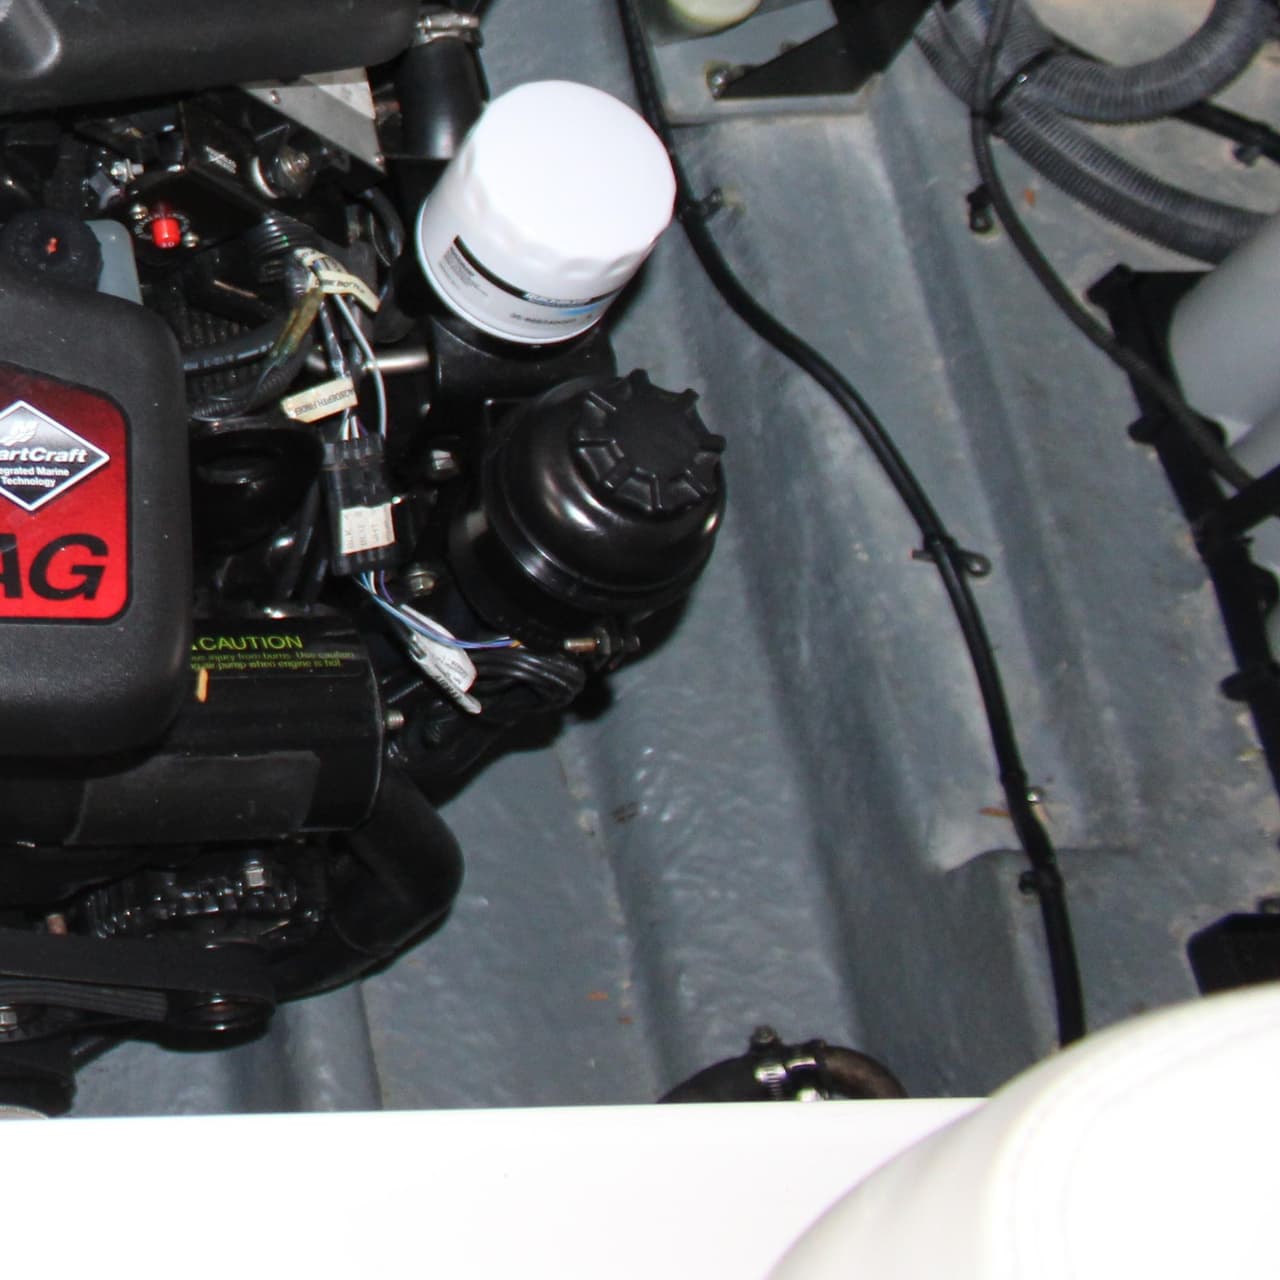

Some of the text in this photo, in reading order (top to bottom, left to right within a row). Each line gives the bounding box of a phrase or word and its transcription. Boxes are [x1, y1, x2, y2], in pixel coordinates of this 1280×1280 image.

[36, 466, 70, 478] Marine
[1, 475, 57, 489] Technology
[199, 635, 304, 651] CAUTION
